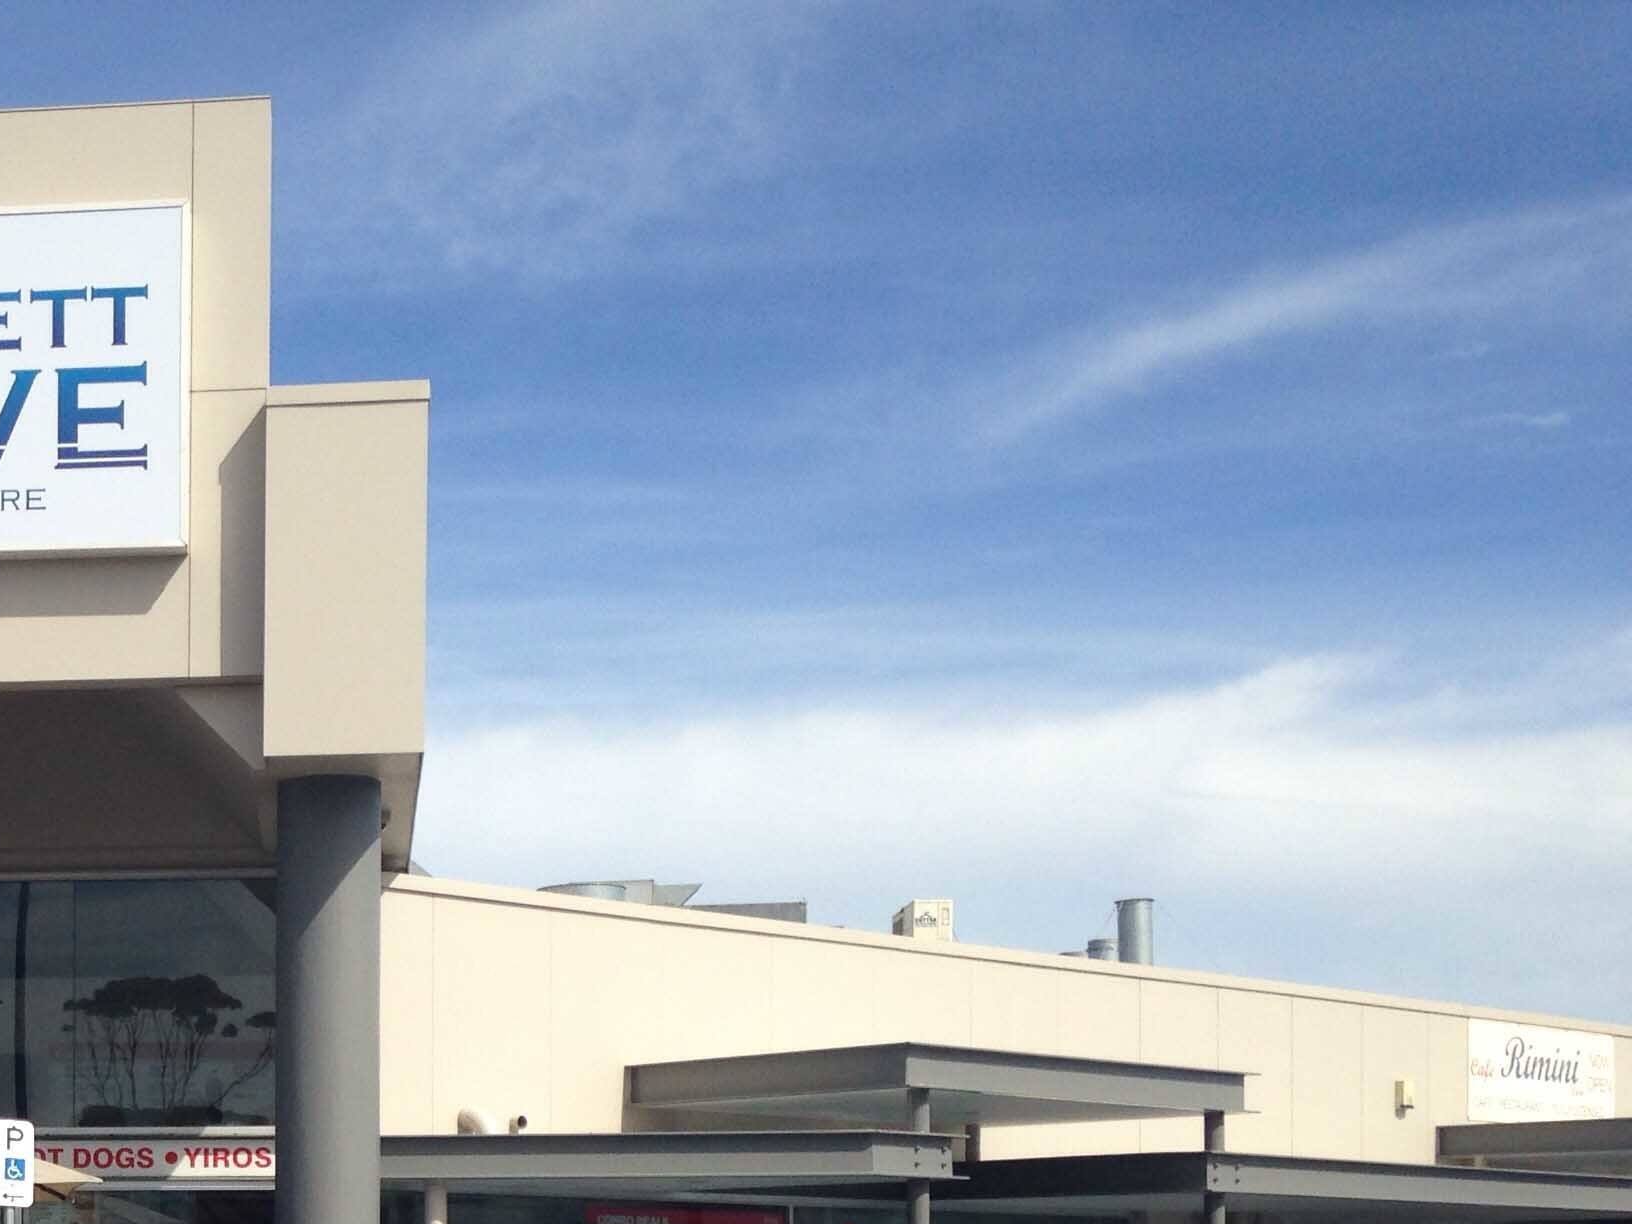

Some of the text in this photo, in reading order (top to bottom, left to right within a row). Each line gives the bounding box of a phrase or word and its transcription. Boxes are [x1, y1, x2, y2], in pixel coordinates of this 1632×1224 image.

[1500, 1036, 1581, 1084] Rimini
[6, 1126, 24, 1150] P
[73, 1147, 154, 1168] DOGS
[183, 1146, 273, 1168] YIROS
